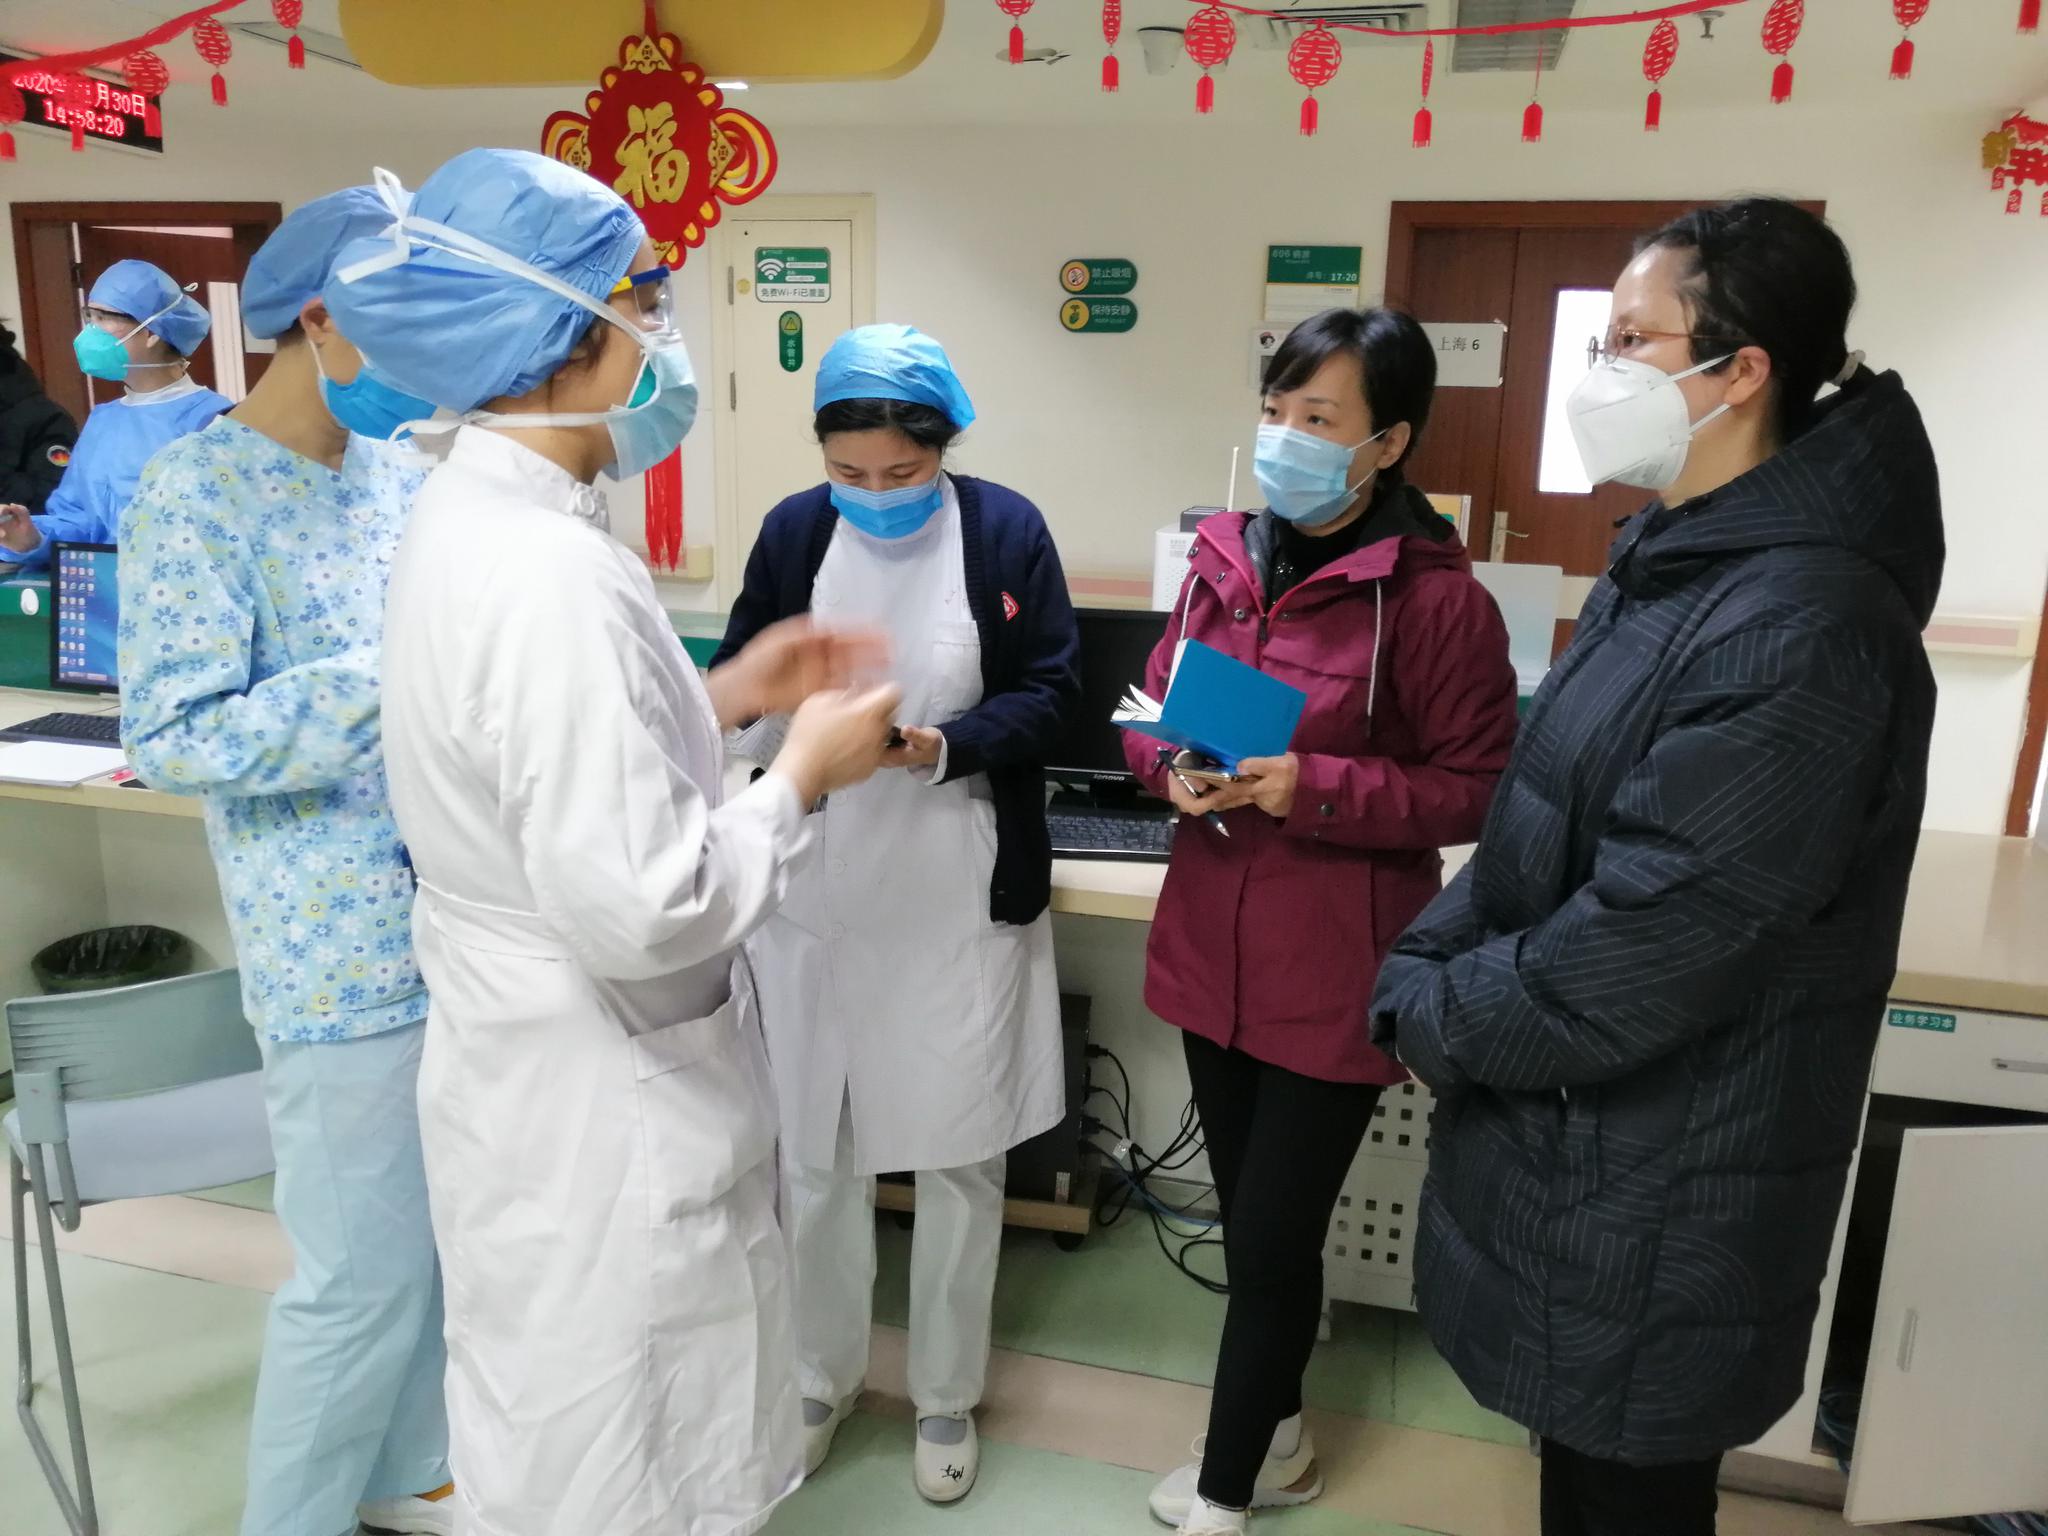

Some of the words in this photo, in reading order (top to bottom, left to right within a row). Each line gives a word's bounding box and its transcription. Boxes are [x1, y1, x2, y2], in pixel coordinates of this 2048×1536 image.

[613, 101, 690, 209] 福
[1092, 267, 1131, 278] 禁止吸烟
[1331, 273, 1357, 282] 17-20
[761, 287, 826, 298] 免费Wi-Fi已覆盖
[1091, 304, 1131, 316] 保持安静
[1438, 336, 1468, 352] 上海
[1472, 338, 1480, 351] 6
